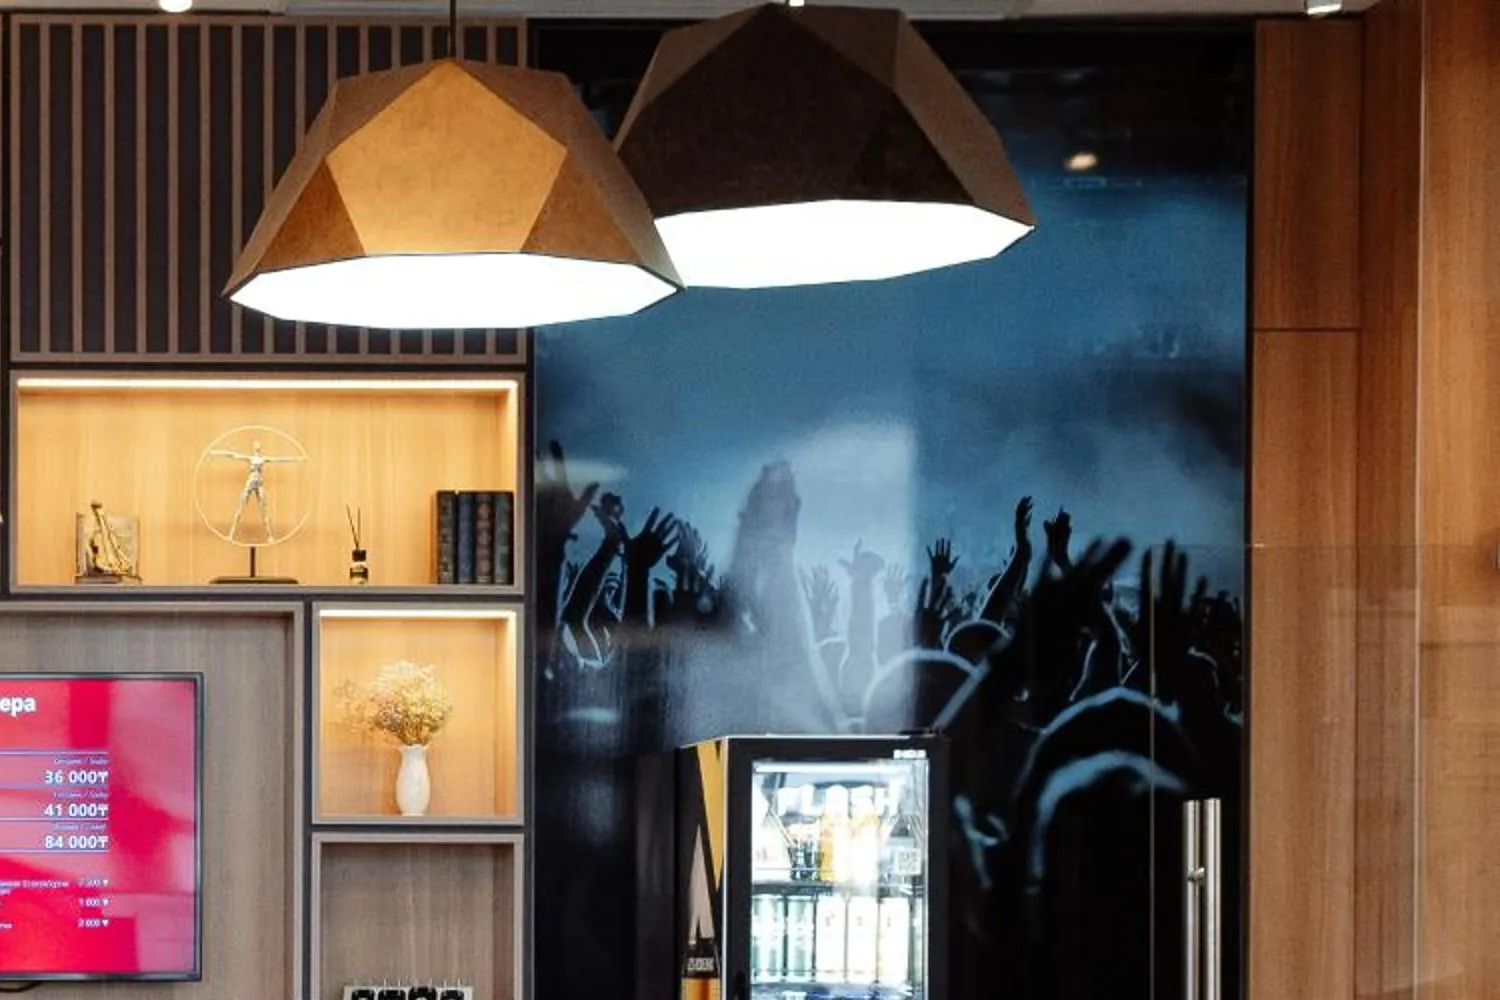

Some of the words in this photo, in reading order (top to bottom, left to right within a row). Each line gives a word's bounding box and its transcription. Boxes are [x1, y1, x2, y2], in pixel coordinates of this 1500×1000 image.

[44, 770, 63, 784] 36
[777, 784, 900, 818] FLSH
[44, 804, 63, 817] 41
[45, 836, 63, 849] 84
